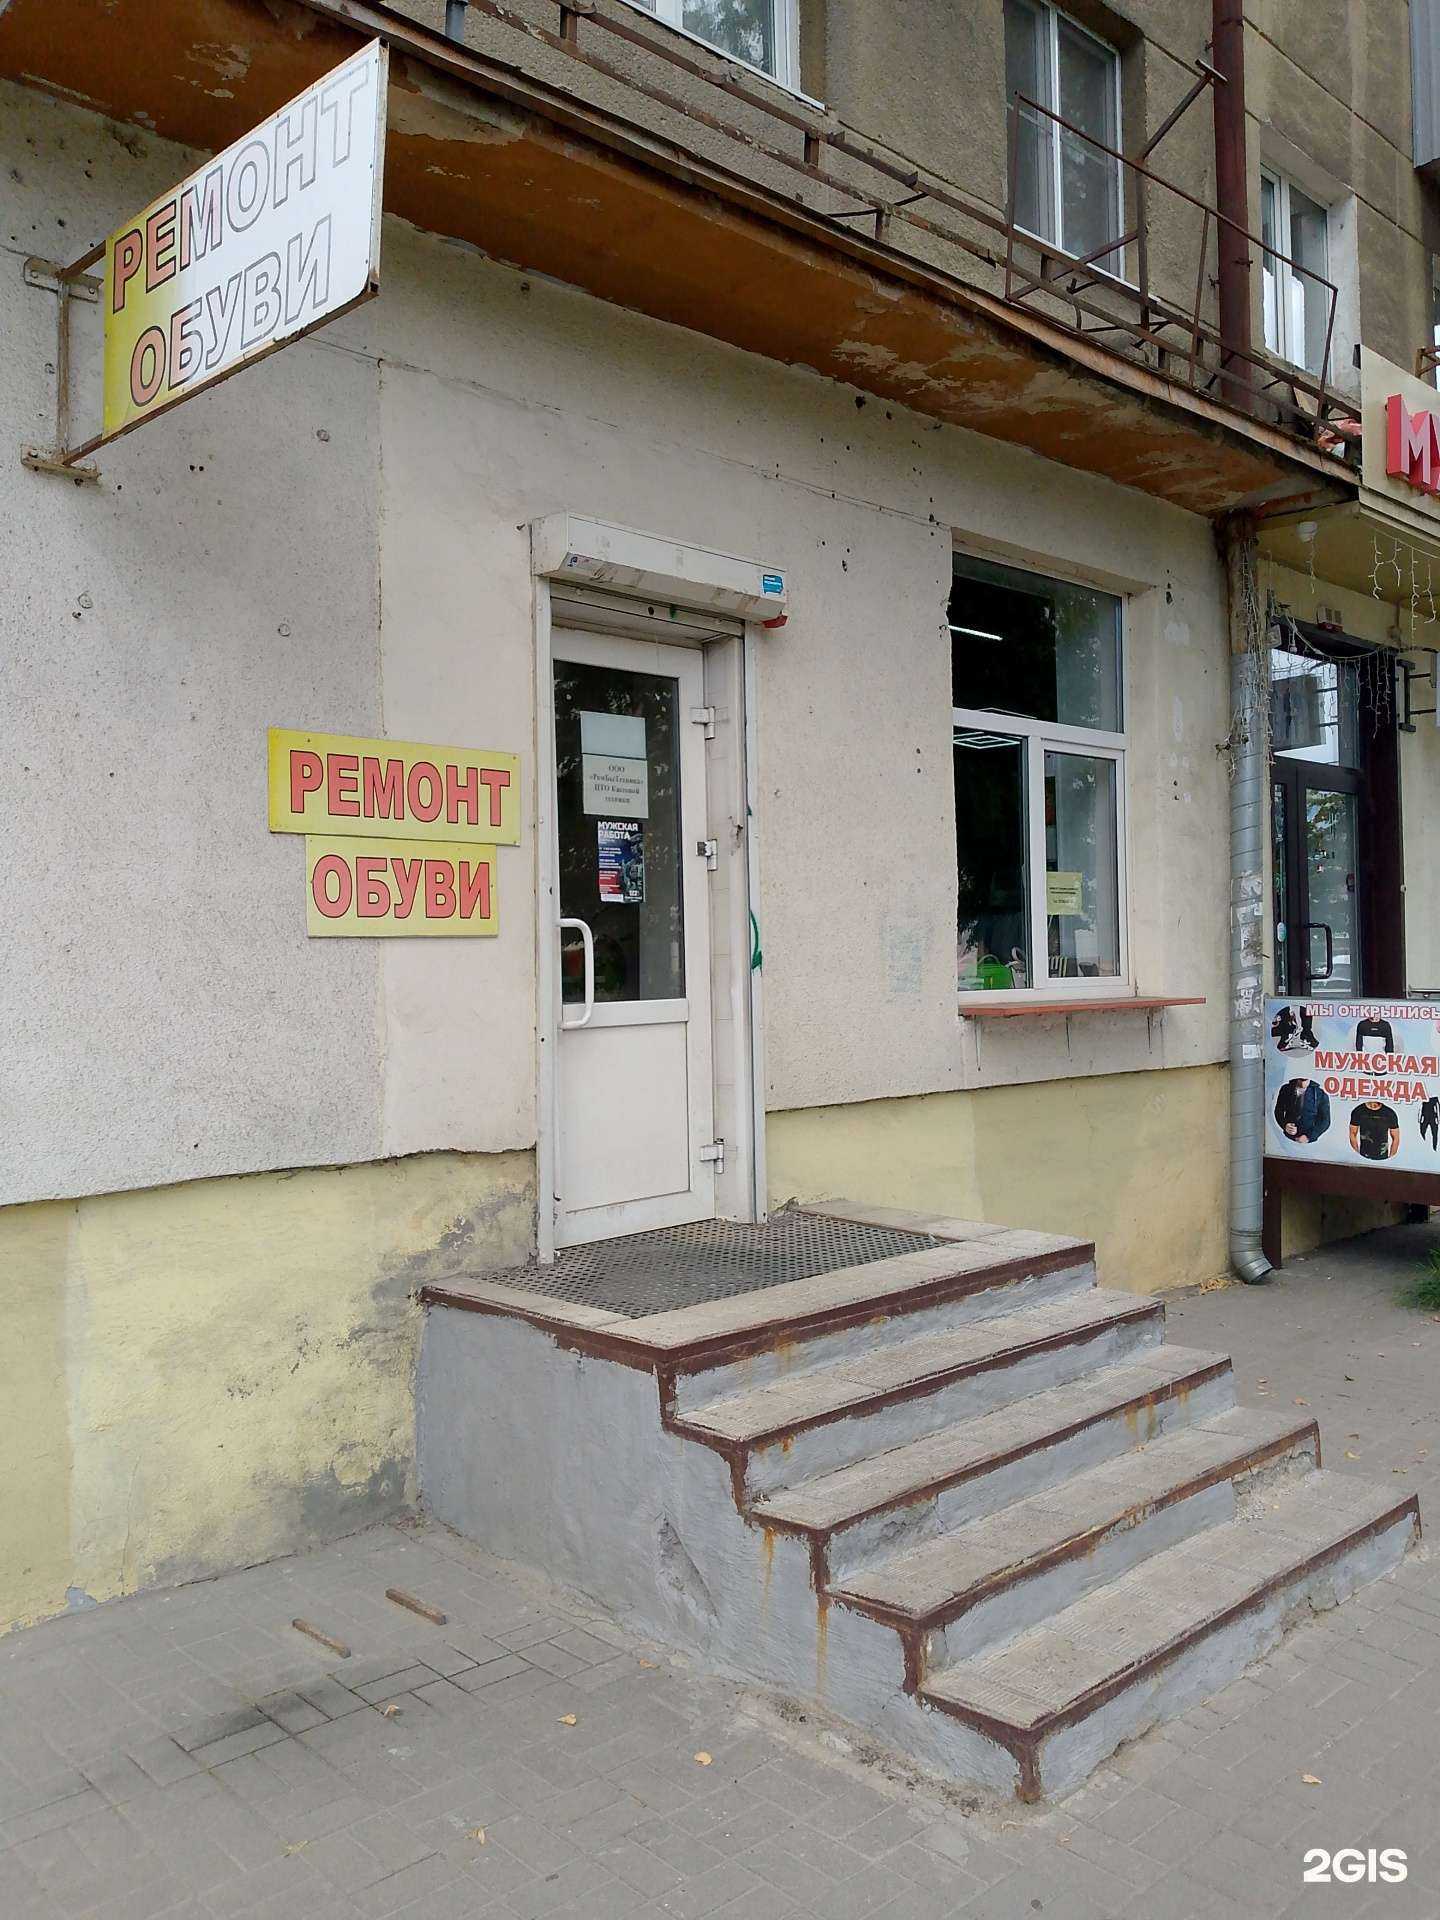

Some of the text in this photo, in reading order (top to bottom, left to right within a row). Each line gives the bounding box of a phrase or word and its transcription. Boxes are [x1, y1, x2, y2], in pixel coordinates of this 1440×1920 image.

[112, 60, 369, 314] РЕМОНТ
[130, 214, 332, 407] ОБУВИ
[289, 749, 511, 827] РЕМОНТ
[598, 821, 639, 832] МУЖСКАЯ
[598, 830, 631, 840] РАБОТА
[311, 854, 491, 919] ОБУВИ
[1305, 1004, 1440, 1019] МЫ ОТКРЫЛИСЬ
[1314, 1051, 1439, 1075] МУЖСКАЯ
[1323, 1076, 1429, 1102] ОДЕЖДА
